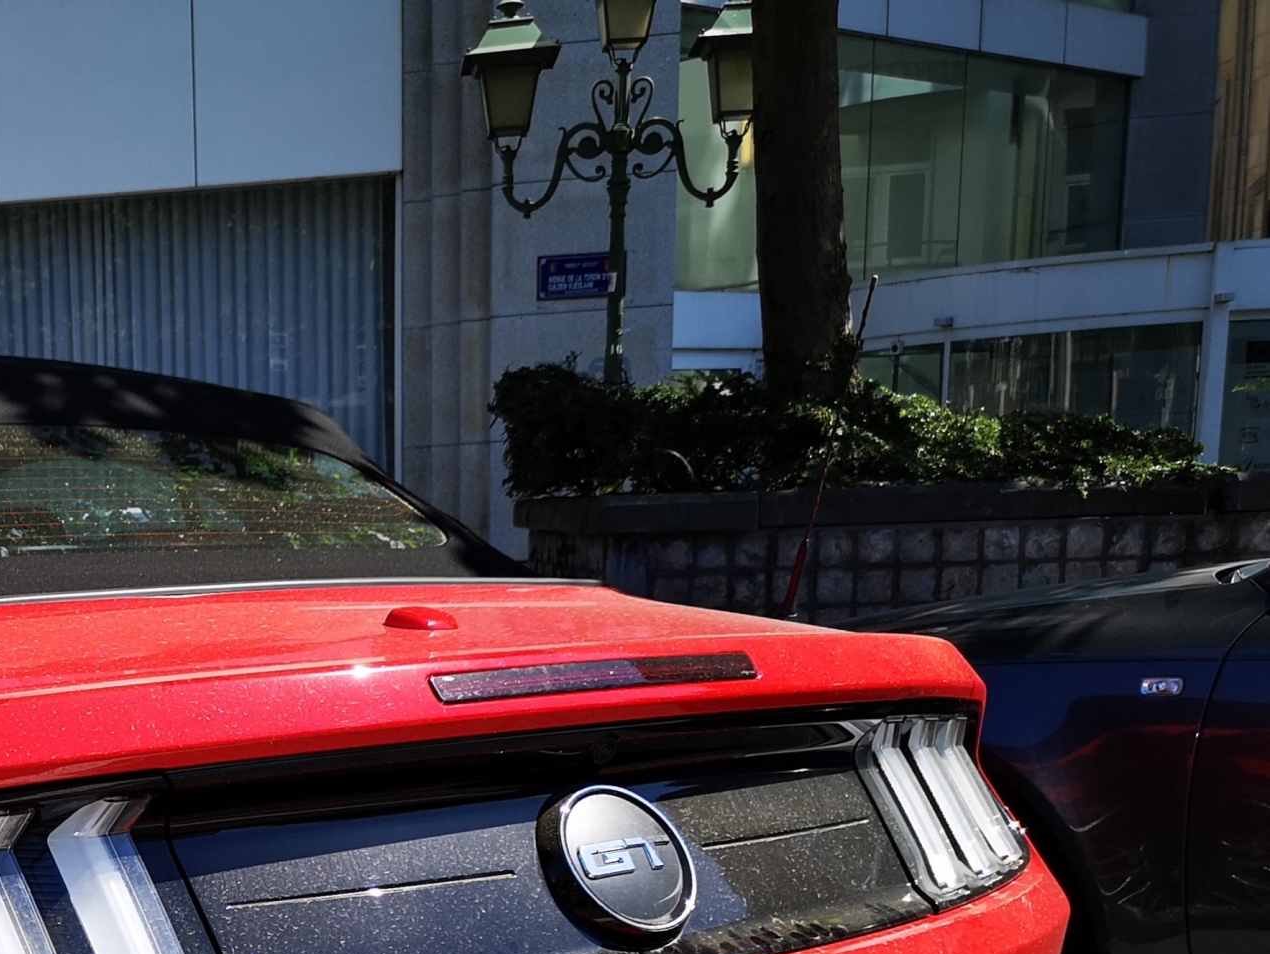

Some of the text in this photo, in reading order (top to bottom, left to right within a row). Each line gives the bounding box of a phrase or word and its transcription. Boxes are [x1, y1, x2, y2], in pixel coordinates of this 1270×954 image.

[548, 274, 566, 283] AVENUE
[567, 274, 574, 282] DE
[575, 273, 582, 282] LA
[583, 273, 601, 282] TOISON
[610, 343, 623, 356] 16
[577, 837, 664, 880] GT
